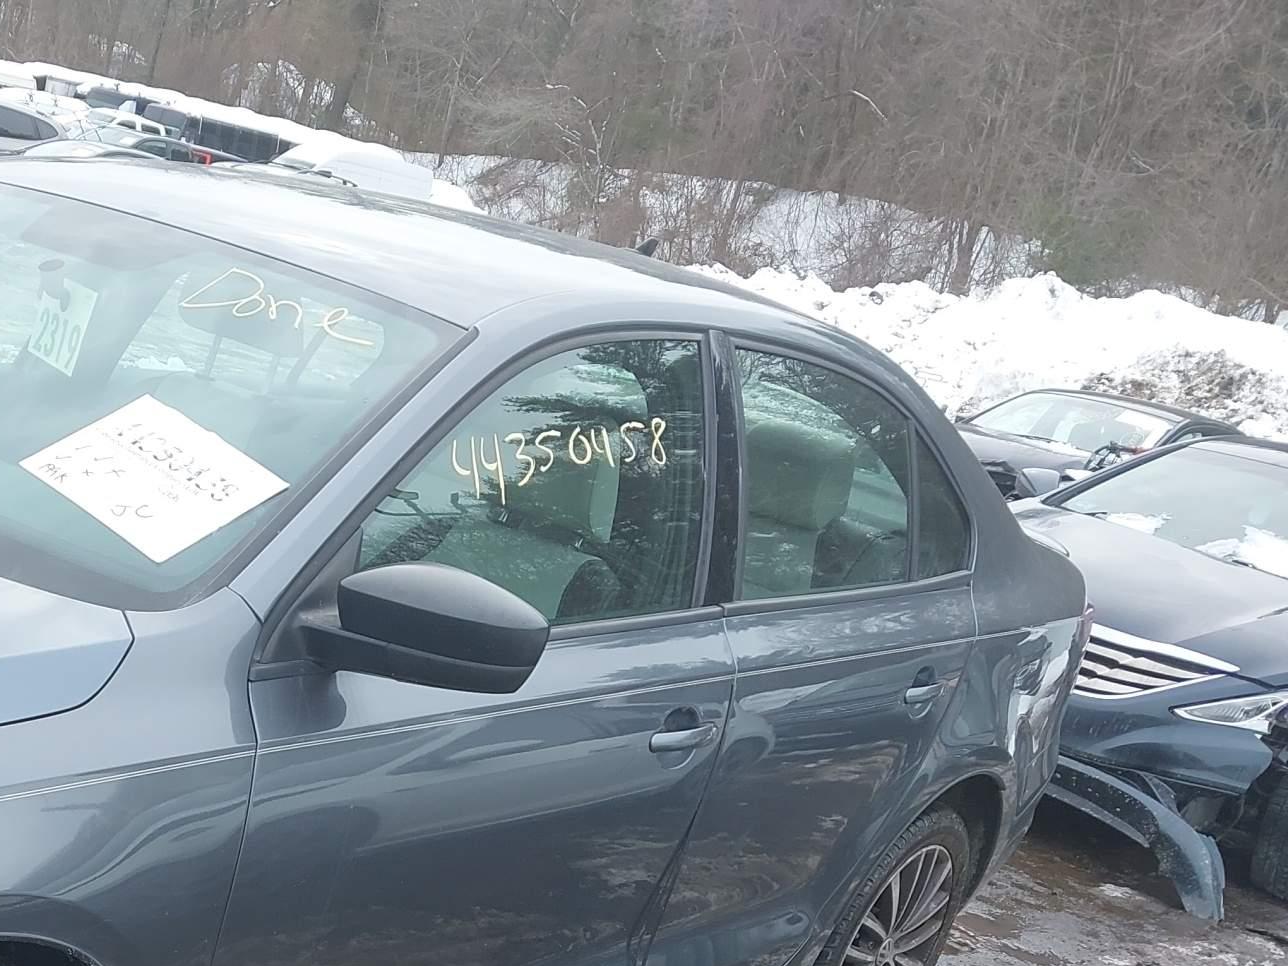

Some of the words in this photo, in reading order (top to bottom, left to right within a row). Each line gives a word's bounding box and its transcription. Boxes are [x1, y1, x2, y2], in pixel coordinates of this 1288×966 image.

[32, 307, 81, 370] 2319
[178, 267, 375, 346] Done
[451, 416, 667, 505] 44350458
